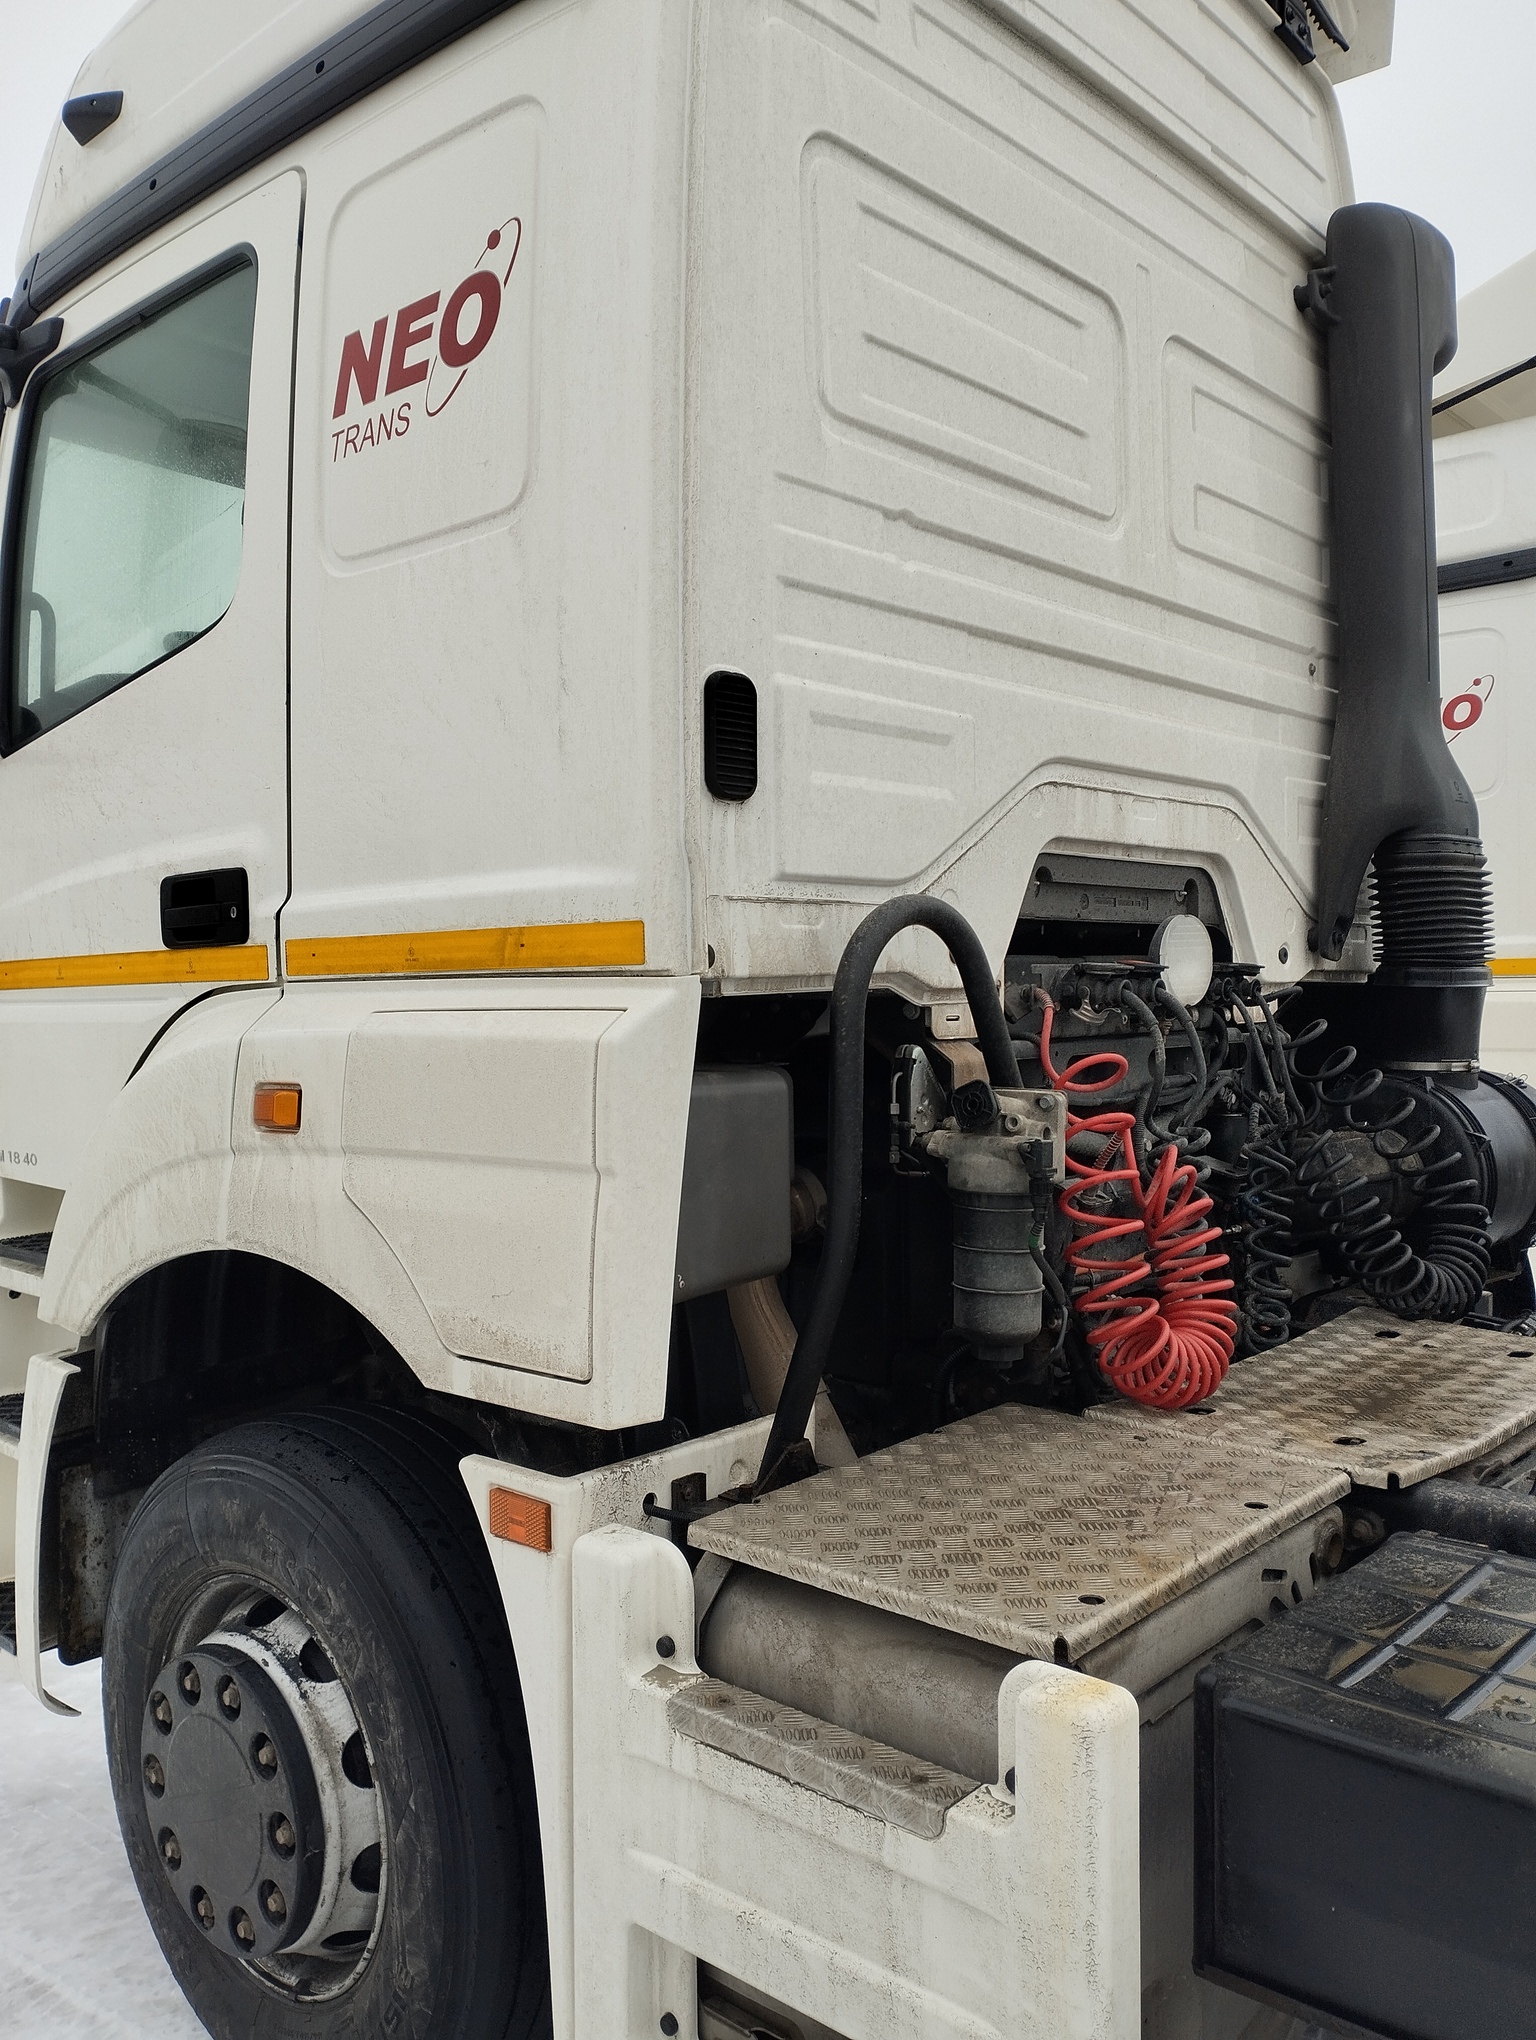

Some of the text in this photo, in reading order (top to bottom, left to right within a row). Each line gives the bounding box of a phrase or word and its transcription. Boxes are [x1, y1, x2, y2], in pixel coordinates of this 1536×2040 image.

[332, 269, 501, 420] NEO
[331, 402, 412, 463] TRANS
[8, 1150, 21, 1165] 18
[23, 1152, 38, 1167] 40
